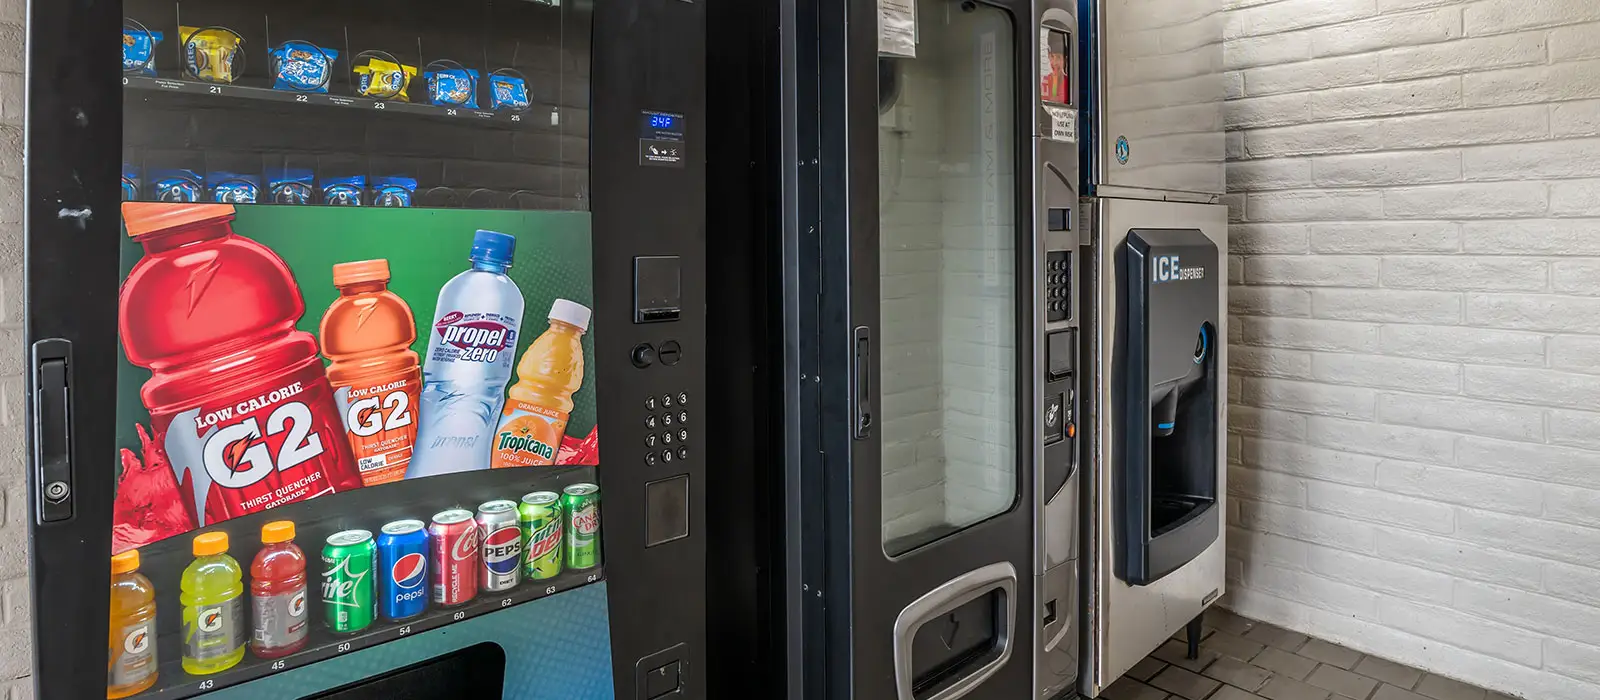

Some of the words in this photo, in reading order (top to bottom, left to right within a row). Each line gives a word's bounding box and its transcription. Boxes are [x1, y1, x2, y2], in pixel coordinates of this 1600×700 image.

[984, 41, 994, 114] MORE
[210, 86, 222, 94] 21
[374, 102, 385, 110] 23
[652, 116, 671, 127] 34F
[1153, 256, 1180, 282] ICE
[1180, 267, 1204, 280] DISPENSER
[441, 325, 507, 348] propel
[461, 346, 498, 363] zero
[348, 388, 368, 398] LOW
[369, 380, 407, 394] CALORIE
[195, 408, 233, 429] LOW
[236, 381, 303, 415] CALORIE
[650, 399, 655, 408] 1
[665, 396, 671, 406] 2
[681, 394, 687, 403] 3
[347, 390, 413, 437] G2
[518, 402, 542, 413] ORANGE
[542, 408, 559, 418] JUICE
[649, 417, 655, 427] 4
[665, 415, 671, 425] 5
[681, 412, 687, 422] 6
[203, 401, 325, 489] G2
[498, 431, 553, 460] Tropicana
[650, 436, 655, 446] 7
[665, 433, 671, 443] 8
[681, 431, 687, 440] 9
[500, 452, 520, 462] 100%
[521, 457, 544, 466] JUICE
[666, 451, 671, 461] 0
[360, 460, 385, 470] CALORIE
[240, 491, 274, 511] THIRST
[275, 471, 322, 498] QUENCHER
[452, 564, 458, 574] ME
[500, 578, 514, 586] DIET
[396, 587, 425, 604] pepsi
[546, 586, 556, 594] 63
[502, 599, 512, 607] 62
[198, 607, 223, 632] G
[454, 612, 465, 620] 60
[400, 626, 411, 635] 54
[124, 626, 148, 654] G
[338, 642, 350, 652] 50
[272, 660, 285, 670] 45
[199, 680, 213, 691] 43
